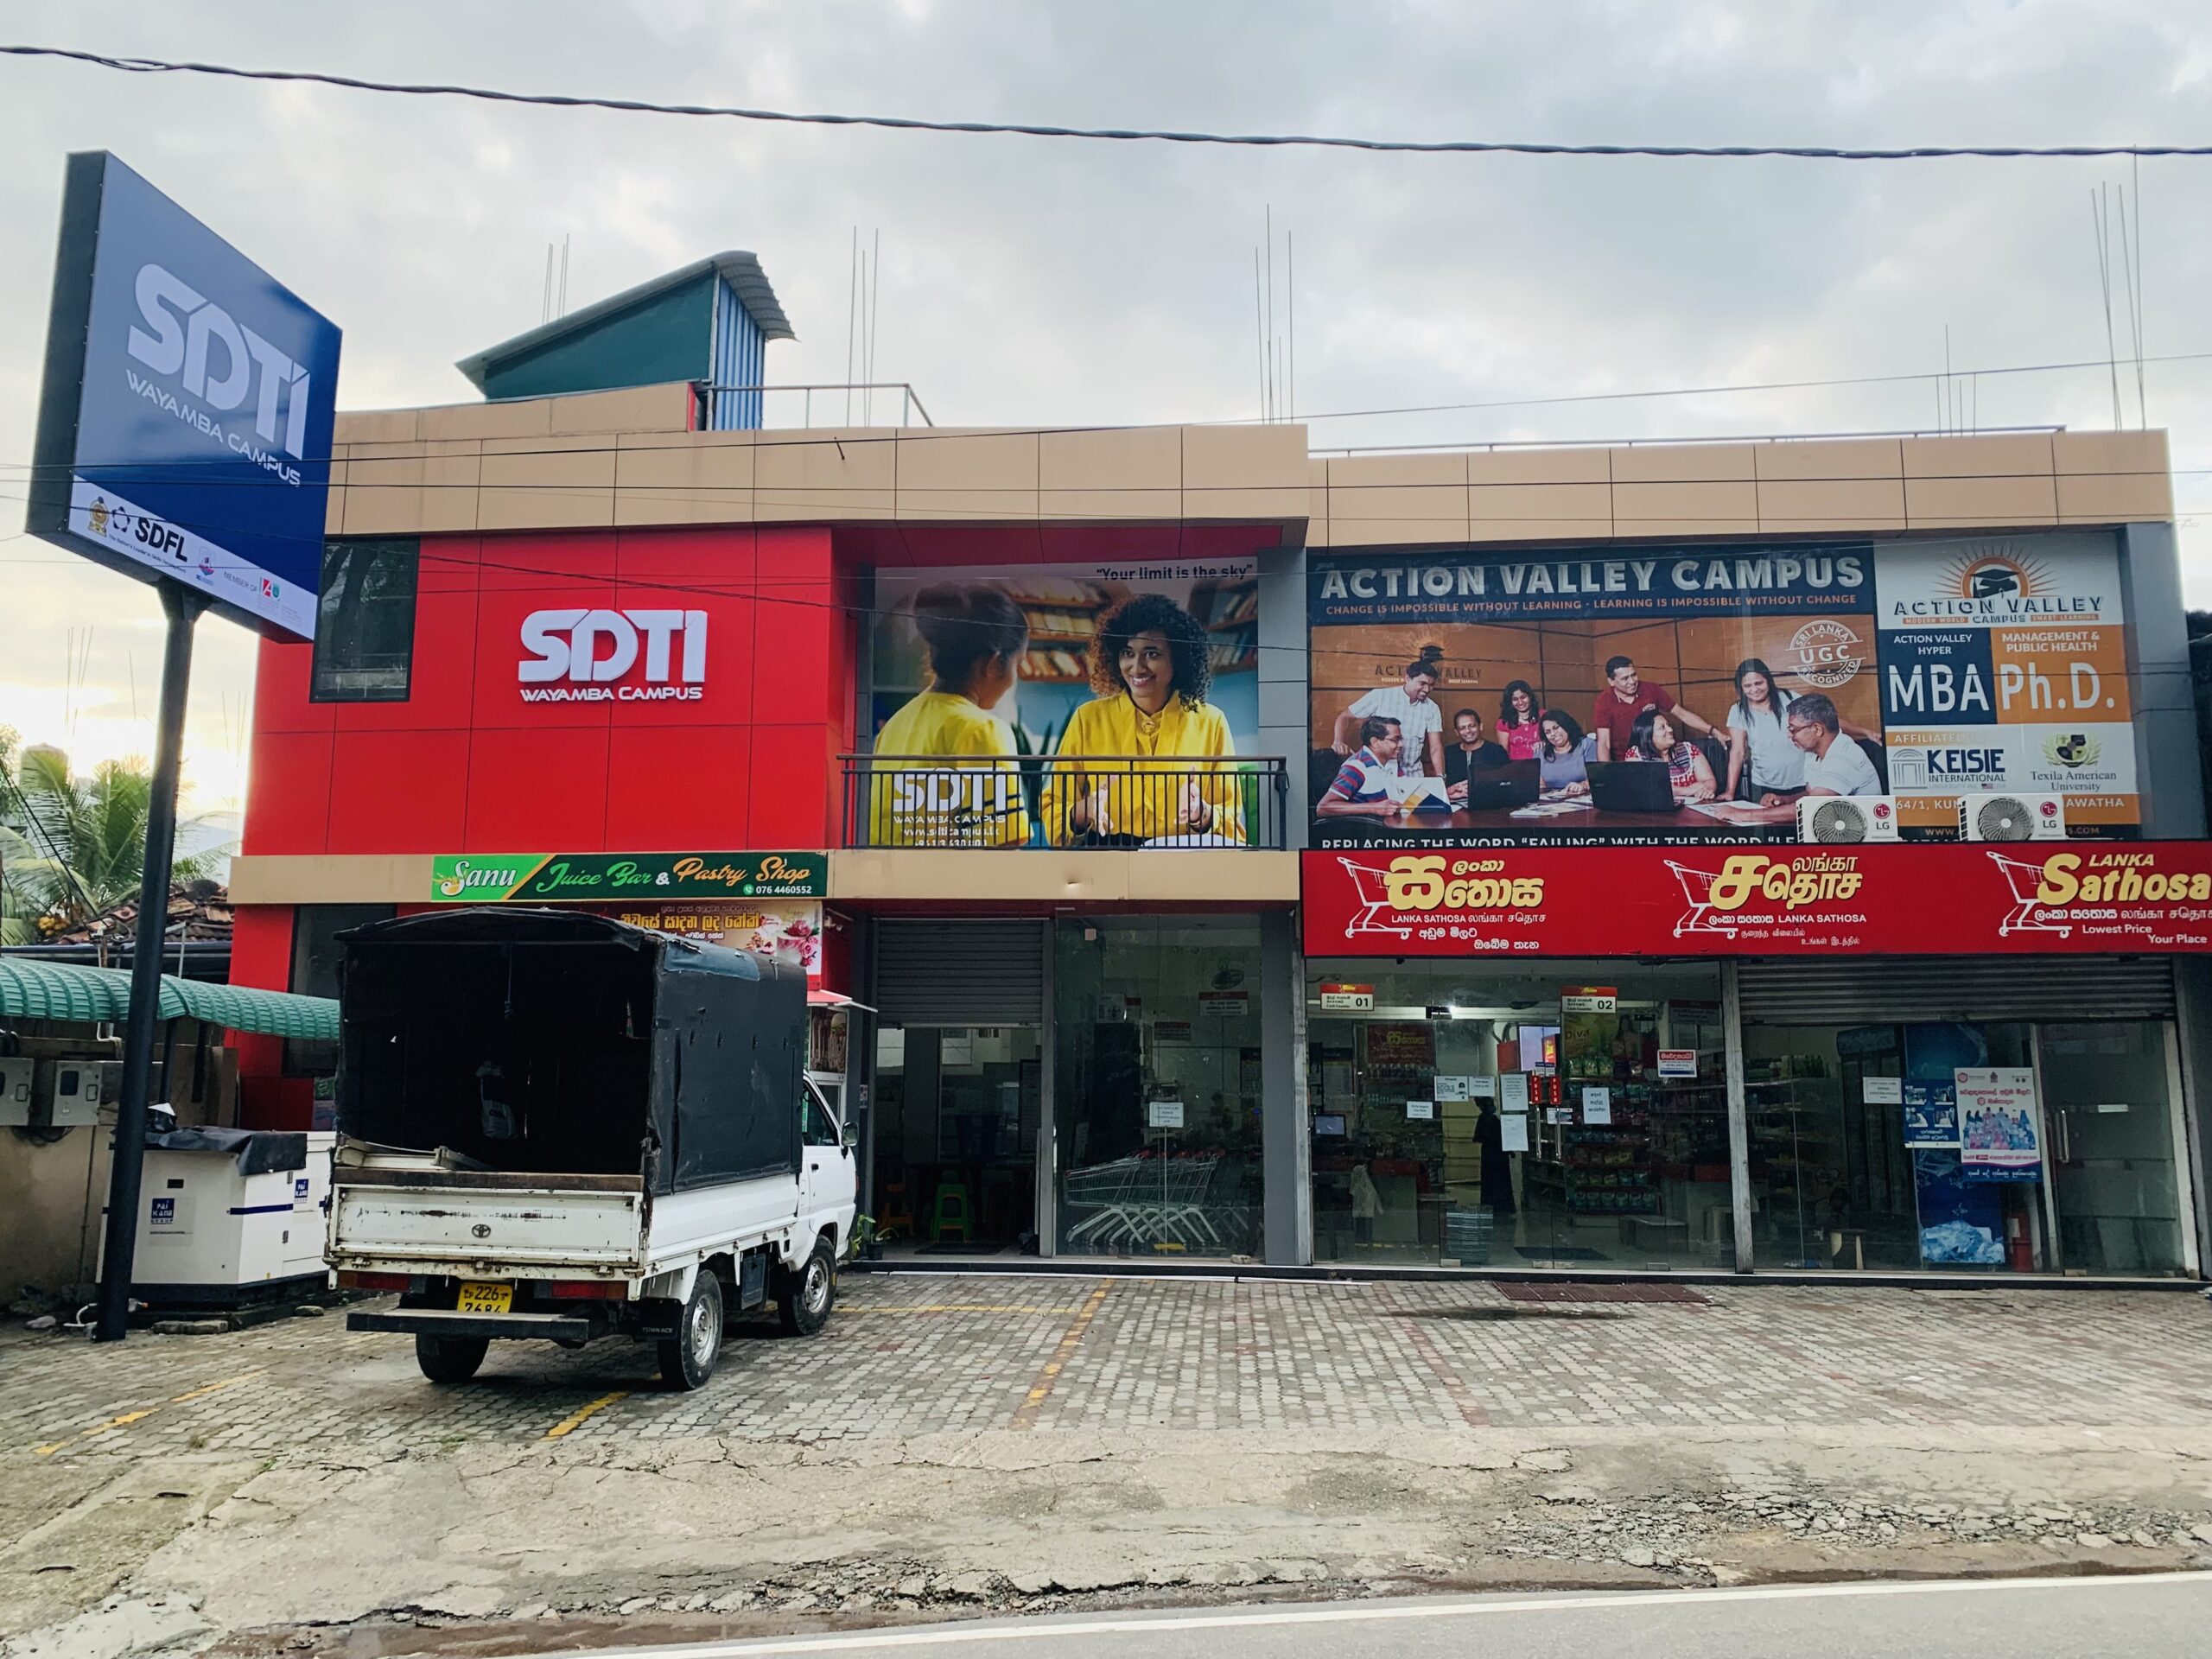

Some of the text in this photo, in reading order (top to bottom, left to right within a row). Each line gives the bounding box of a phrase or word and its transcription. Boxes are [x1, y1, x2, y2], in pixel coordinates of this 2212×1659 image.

[127, 263, 311, 461] SDTI
[125, 368, 302, 486] WAYAMBA CAMPUS
[135, 517, 188, 563] SDFL
[1139, 566, 1173, 581] limit
[1176, 566, 1190, 580] is
[1193, 565, 1217, 579] the
[1319, 556, 1864, 600] ACTION VALLEY CAMPUS
[224, 570, 250, 588] MEMBER
[249, 583, 258, 593] OF
[1326, 594, 1857, 615] CHANGE IS IMPOSSIBLE WITHOUT LEARNING LEARNING IS IMPOSSIBLE WITHOUT CHANGE
[1893, 595, 2105, 615] ACTION VALLEY
[1972, 614, 2026, 624] CAMPUS
[1796, 624, 1849, 646] SRI LANKA
[1893, 633, 1973, 644] ACTION VALLEY
[2002, 631, 2100, 643] MANAGEMENT &
[518, 608, 709, 683] SDTI
[1917, 646, 1952, 655] HYPER
[2006, 641, 2098, 652] PUBLIC HEALTH
[1799, 645, 1851, 664] UGC
[1800, 660, 1856, 683] RECOGNIZED
[1888, 663, 1990, 712] MBA
[1999, 662, 2115, 710] Ph.D.
[520, 686, 703, 702] WAYAMBA CAMPUS
[1927, 748, 2005, 774] KEISIE
[1929, 773, 2007, 783] INTERNATIONAL
[2030, 770, 2117, 781] Texila American
[2050, 781, 2101, 792] University
[1897, 799, 1929, 810] 64/1,
[2066, 798, 2125, 808] AWATHA
[1876, 822, 1890, 830] LG
[2043, 819, 2057, 829] LG
[1421, 838, 1455, 848] THE
[1792, 851, 1859, 873] லங்கா
[2088, 854, 2155, 867] LANKA
[535, 855, 812, 893] Juice Bar & Pastry Shop
[1451, 859, 1505, 876] ලංකා
[440, 860, 517, 898] Sanu
[2036, 853, 2212, 906] Sathosa
[755, 885, 812, 894] 076 4460552
[1391, 914, 1466, 924] LANKA SATHOSA
[1467, 912, 1503, 924] லங்கா
[1708, 914, 1736, 925] ලංකා
[1777, 913, 1867, 924] LANKA SATHOSA
[2034, 908, 2069, 921] ලංකා
[2120, 906, 2164, 920] லங்கா
[724, 912, 760, 929] කේක්
[1418, 926, 1478, 940] අඩුම මිලට
[2082, 923, 2153, 934] Lowest Price
[1513, 939, 1540, 950] තැන
[2147, 933, 2208, 944] Your Place
[1355, 997, 1369, 1007] 01
[1597, 1000, 1613, 1010] 02
[1565, 1027, 1591, 1040] Diva
[474, 1285, 499, 1301] 226
